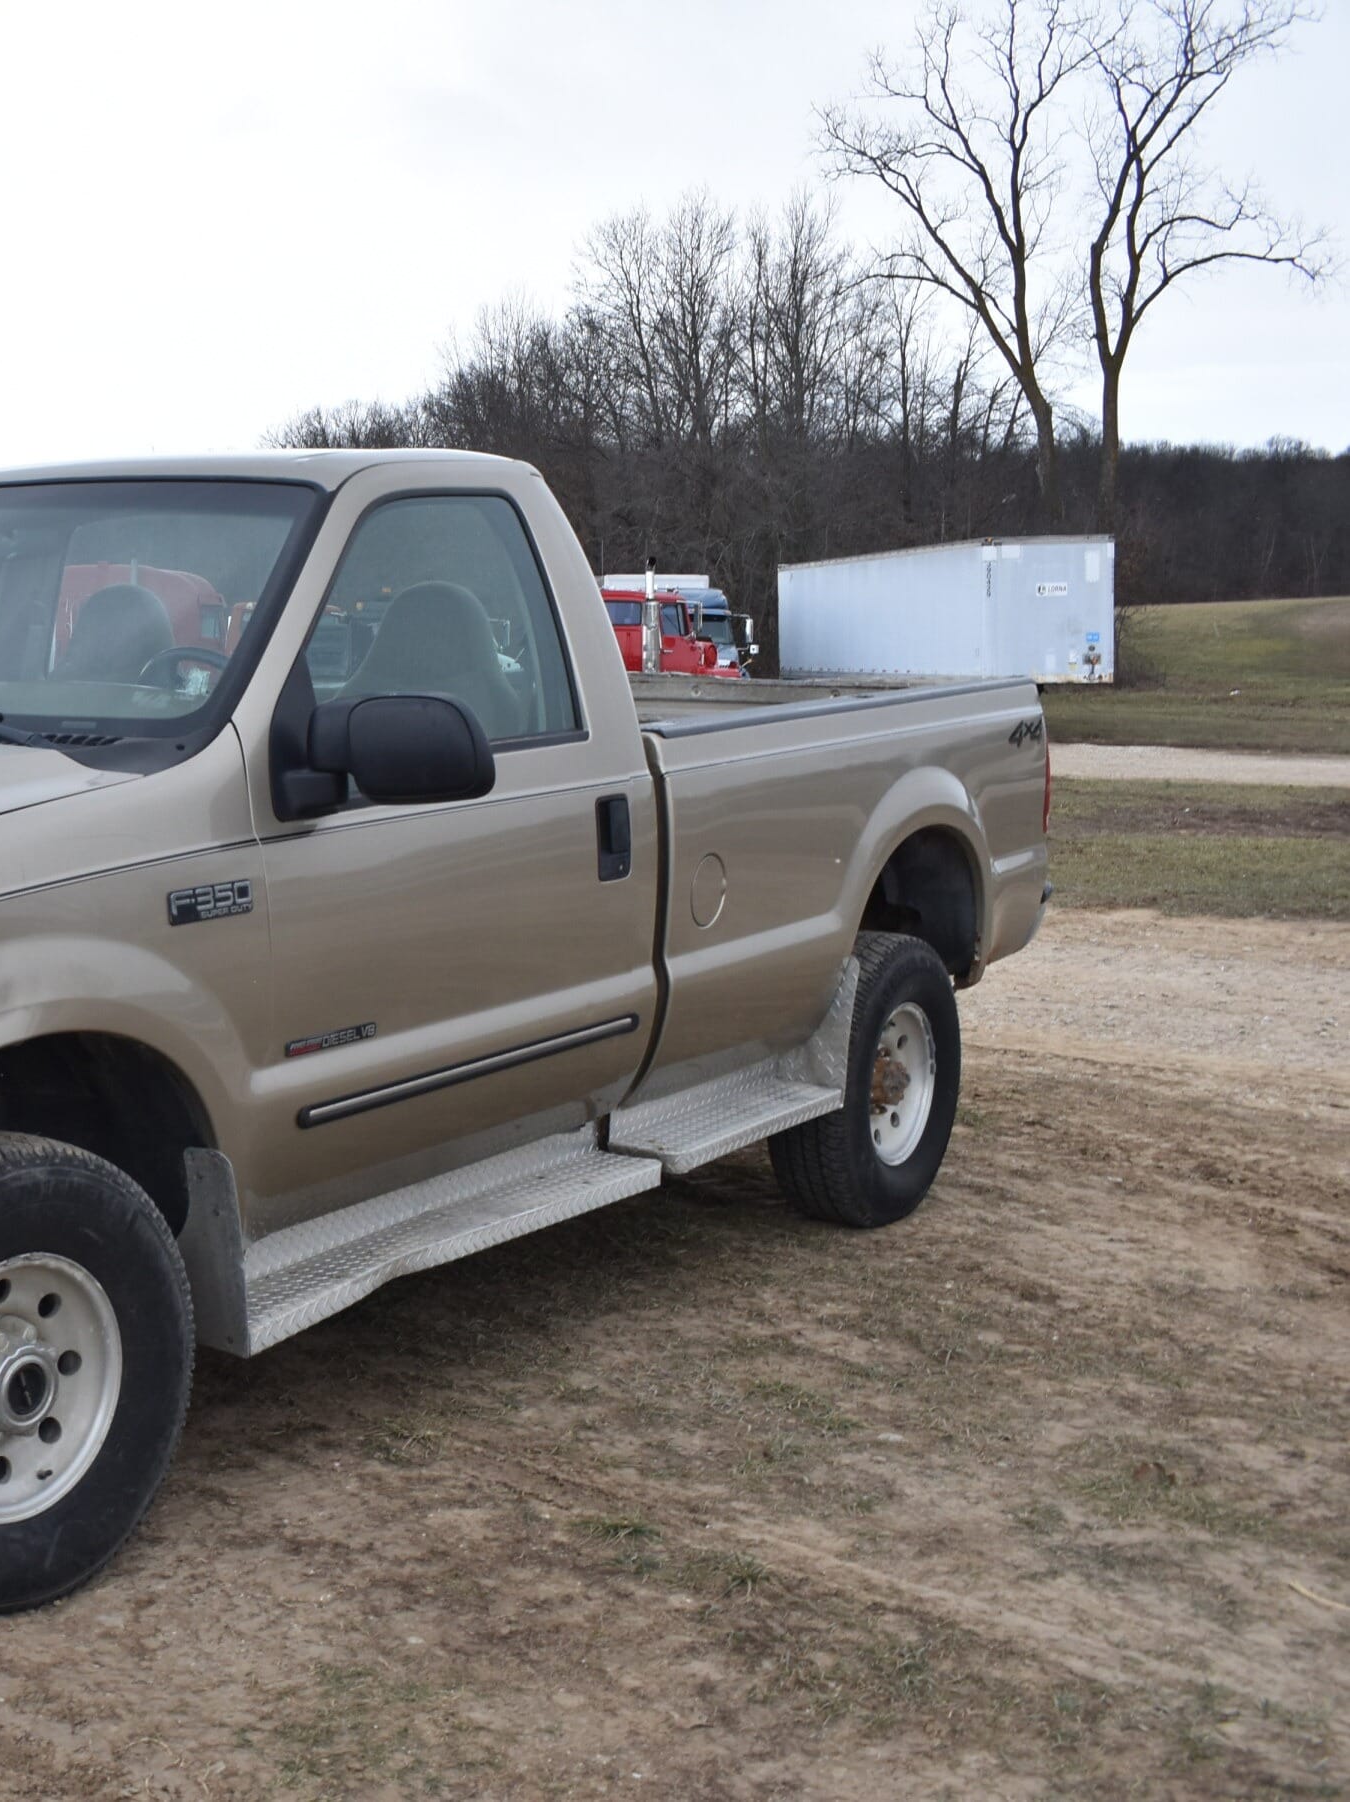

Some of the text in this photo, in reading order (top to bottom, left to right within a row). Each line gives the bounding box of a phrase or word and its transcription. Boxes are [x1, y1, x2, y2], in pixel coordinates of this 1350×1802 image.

[200, 903, 253, 919] SUPER DUTY
[322, 1029, 360, 1048] DIESEL
[361, 1023, 375, 1037] V8
